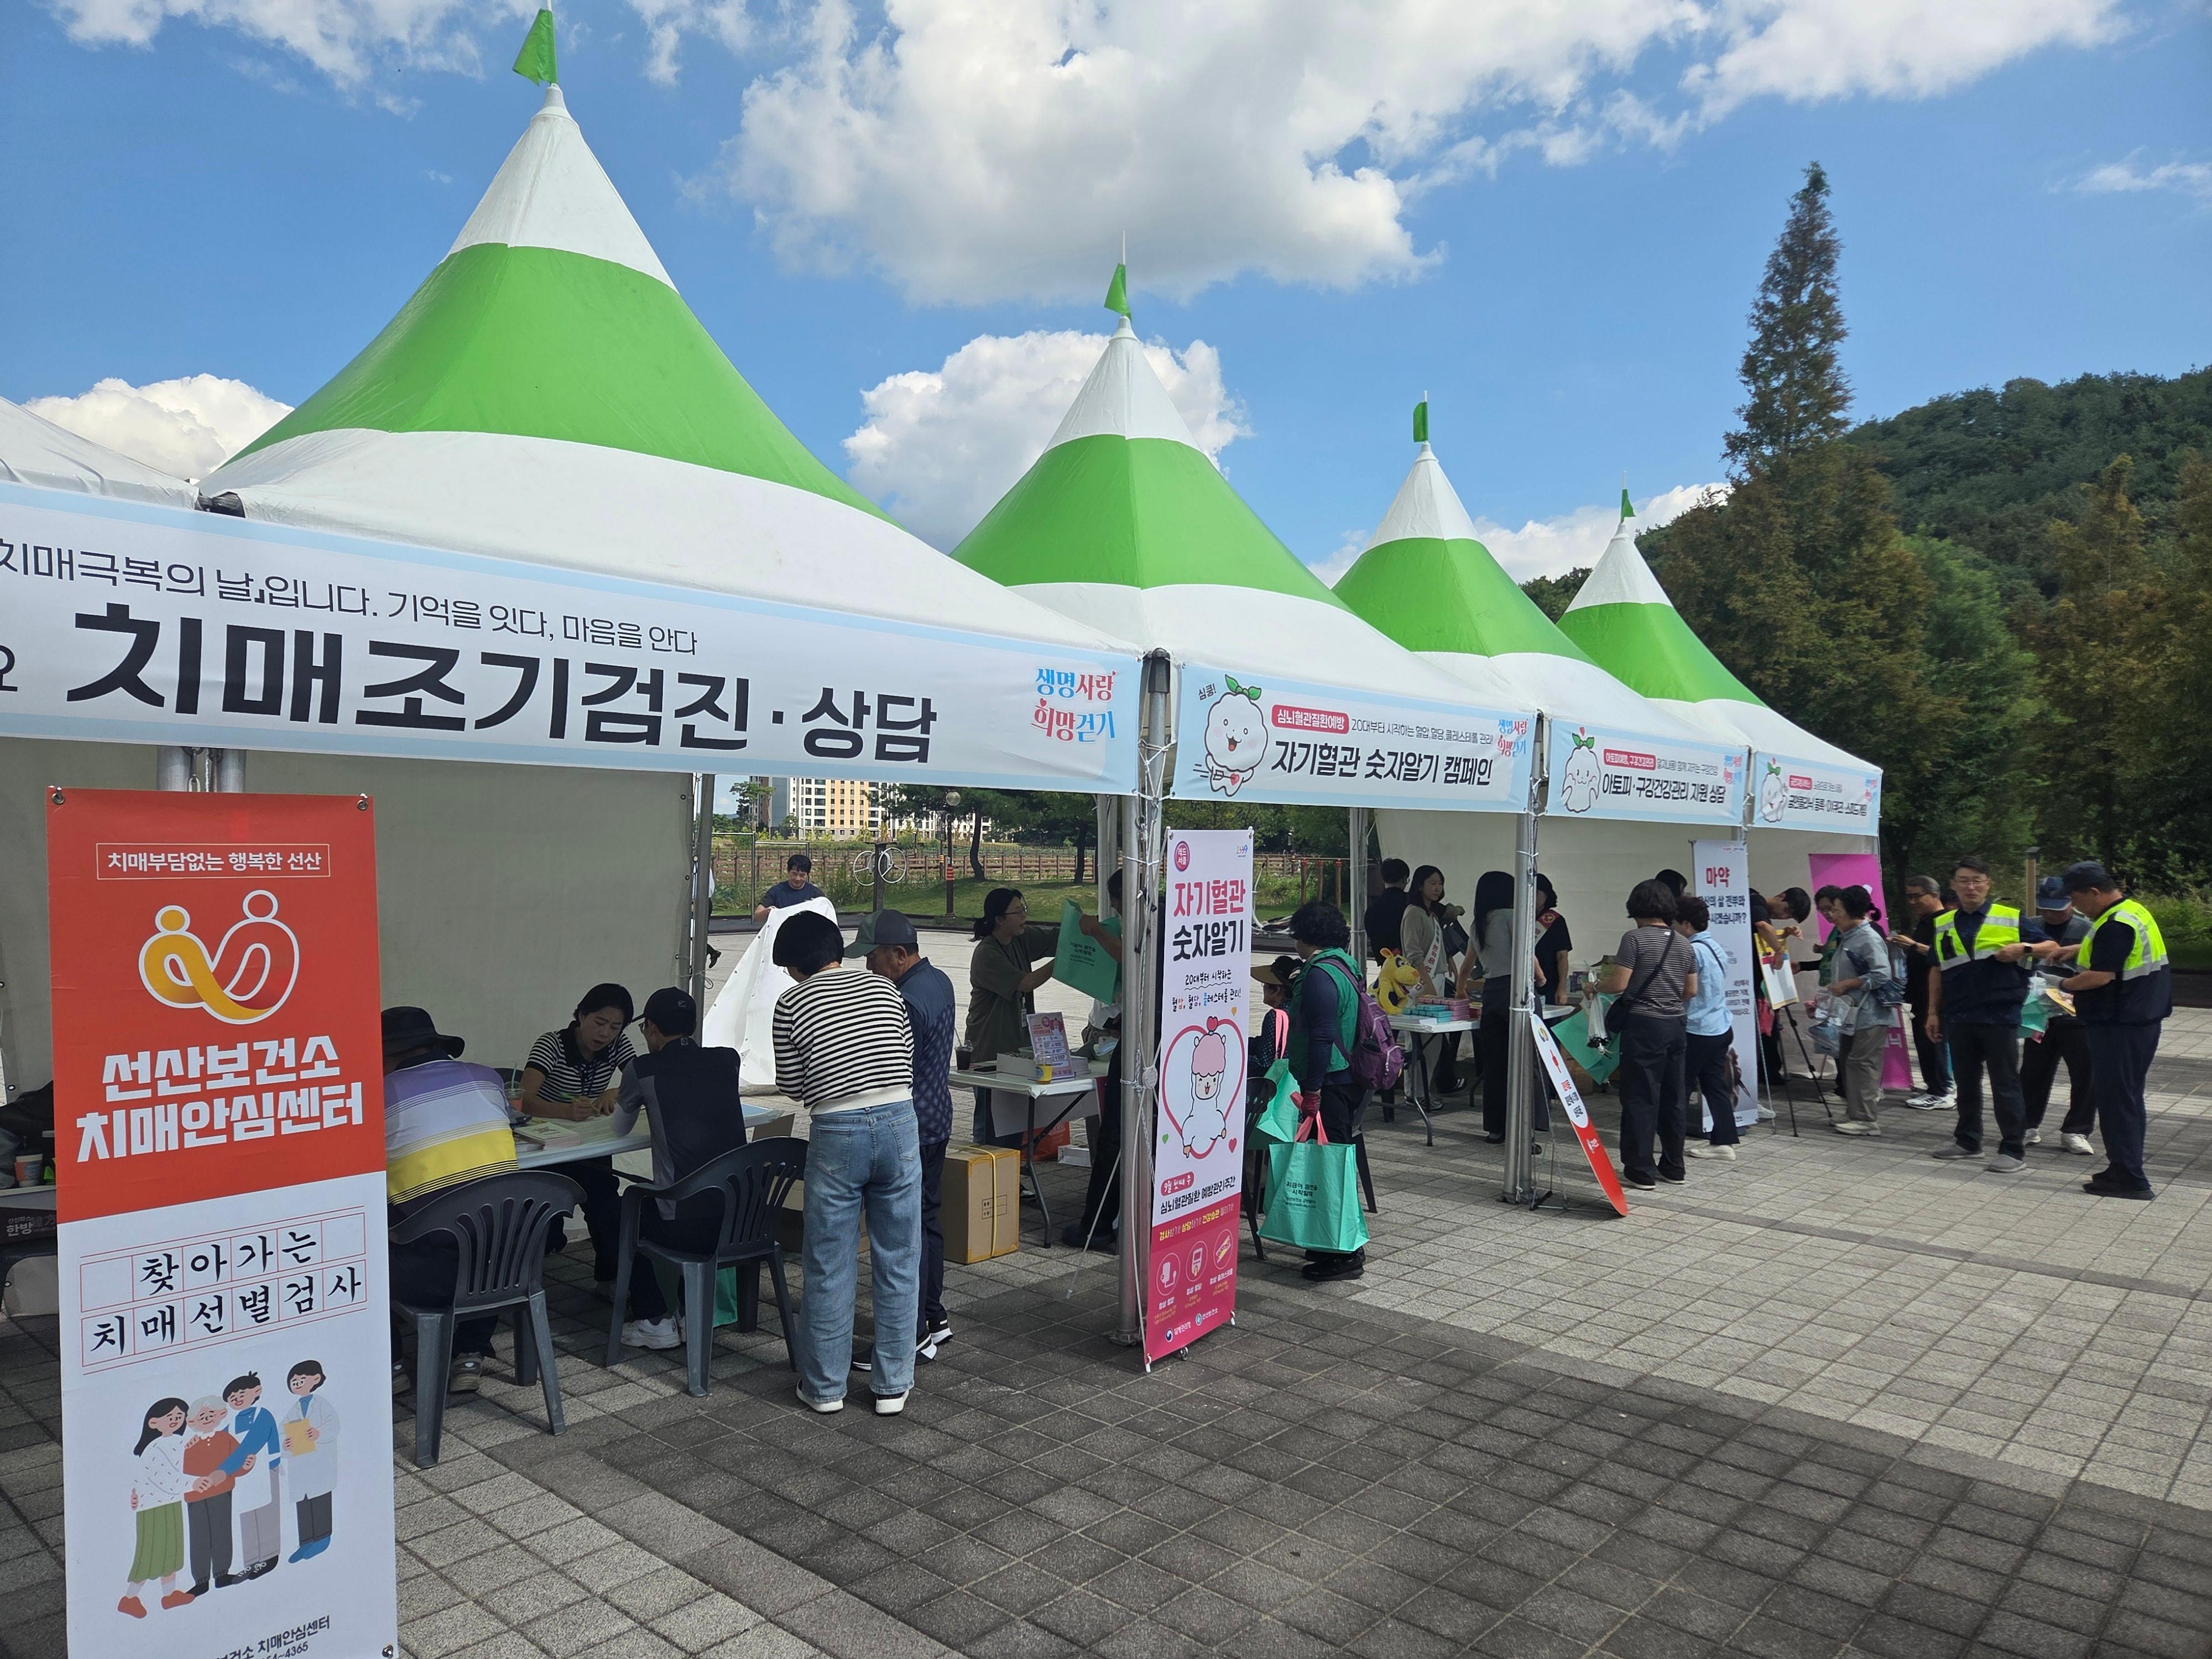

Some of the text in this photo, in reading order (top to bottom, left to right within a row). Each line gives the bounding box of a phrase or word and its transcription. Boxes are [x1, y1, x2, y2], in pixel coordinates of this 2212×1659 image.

[0, 538, 205, 597] 치매극복의
[388, 592, 482, 629] 기억을
[489, 606, 554, 641] 잇다,
[563, 615, 642, 648] 마음을
[649, 627, 697, 655] 안다
[1035, 668, 1114, 701] 생명사랑
[1198, 683, 1217, 701] 심쿵!
[1031, 699, 1115, 742] 희망걷기
[1277, 709, 1345, 730] 심뇌혈관질환예방
[1351, 718, 1385, 734] 20대부터
[1386, 724, 1415, 737] 시작하는
[1271, 740, 1493, 786] 자기혈관 숫자알기 캠페인
[108, 852, 321, 872] 치매부담없는 행복한 선산
[1705, 867, 1730, 888] 마약
[1173, 879, 1245, 917] 자기혈관
[1172, 919, 1244, 962] 숫자알기
[1185, 968, 1232, 985] 20대부터 시작하는
[102, 1035, 340, 1102] 선산보건소
[76, 1082, 363, 1163] 치매안심센터
[1161, 1189, 1201, 1215] 심뇌혈관질환
[6, 1222, 33, 1237] 한방
[141, 1230, 317, 1296] 찾아가는
[90, 1266, 362, 1357] 치매선별검사
[258, 1615, 330, 1653] 치매안심센터
